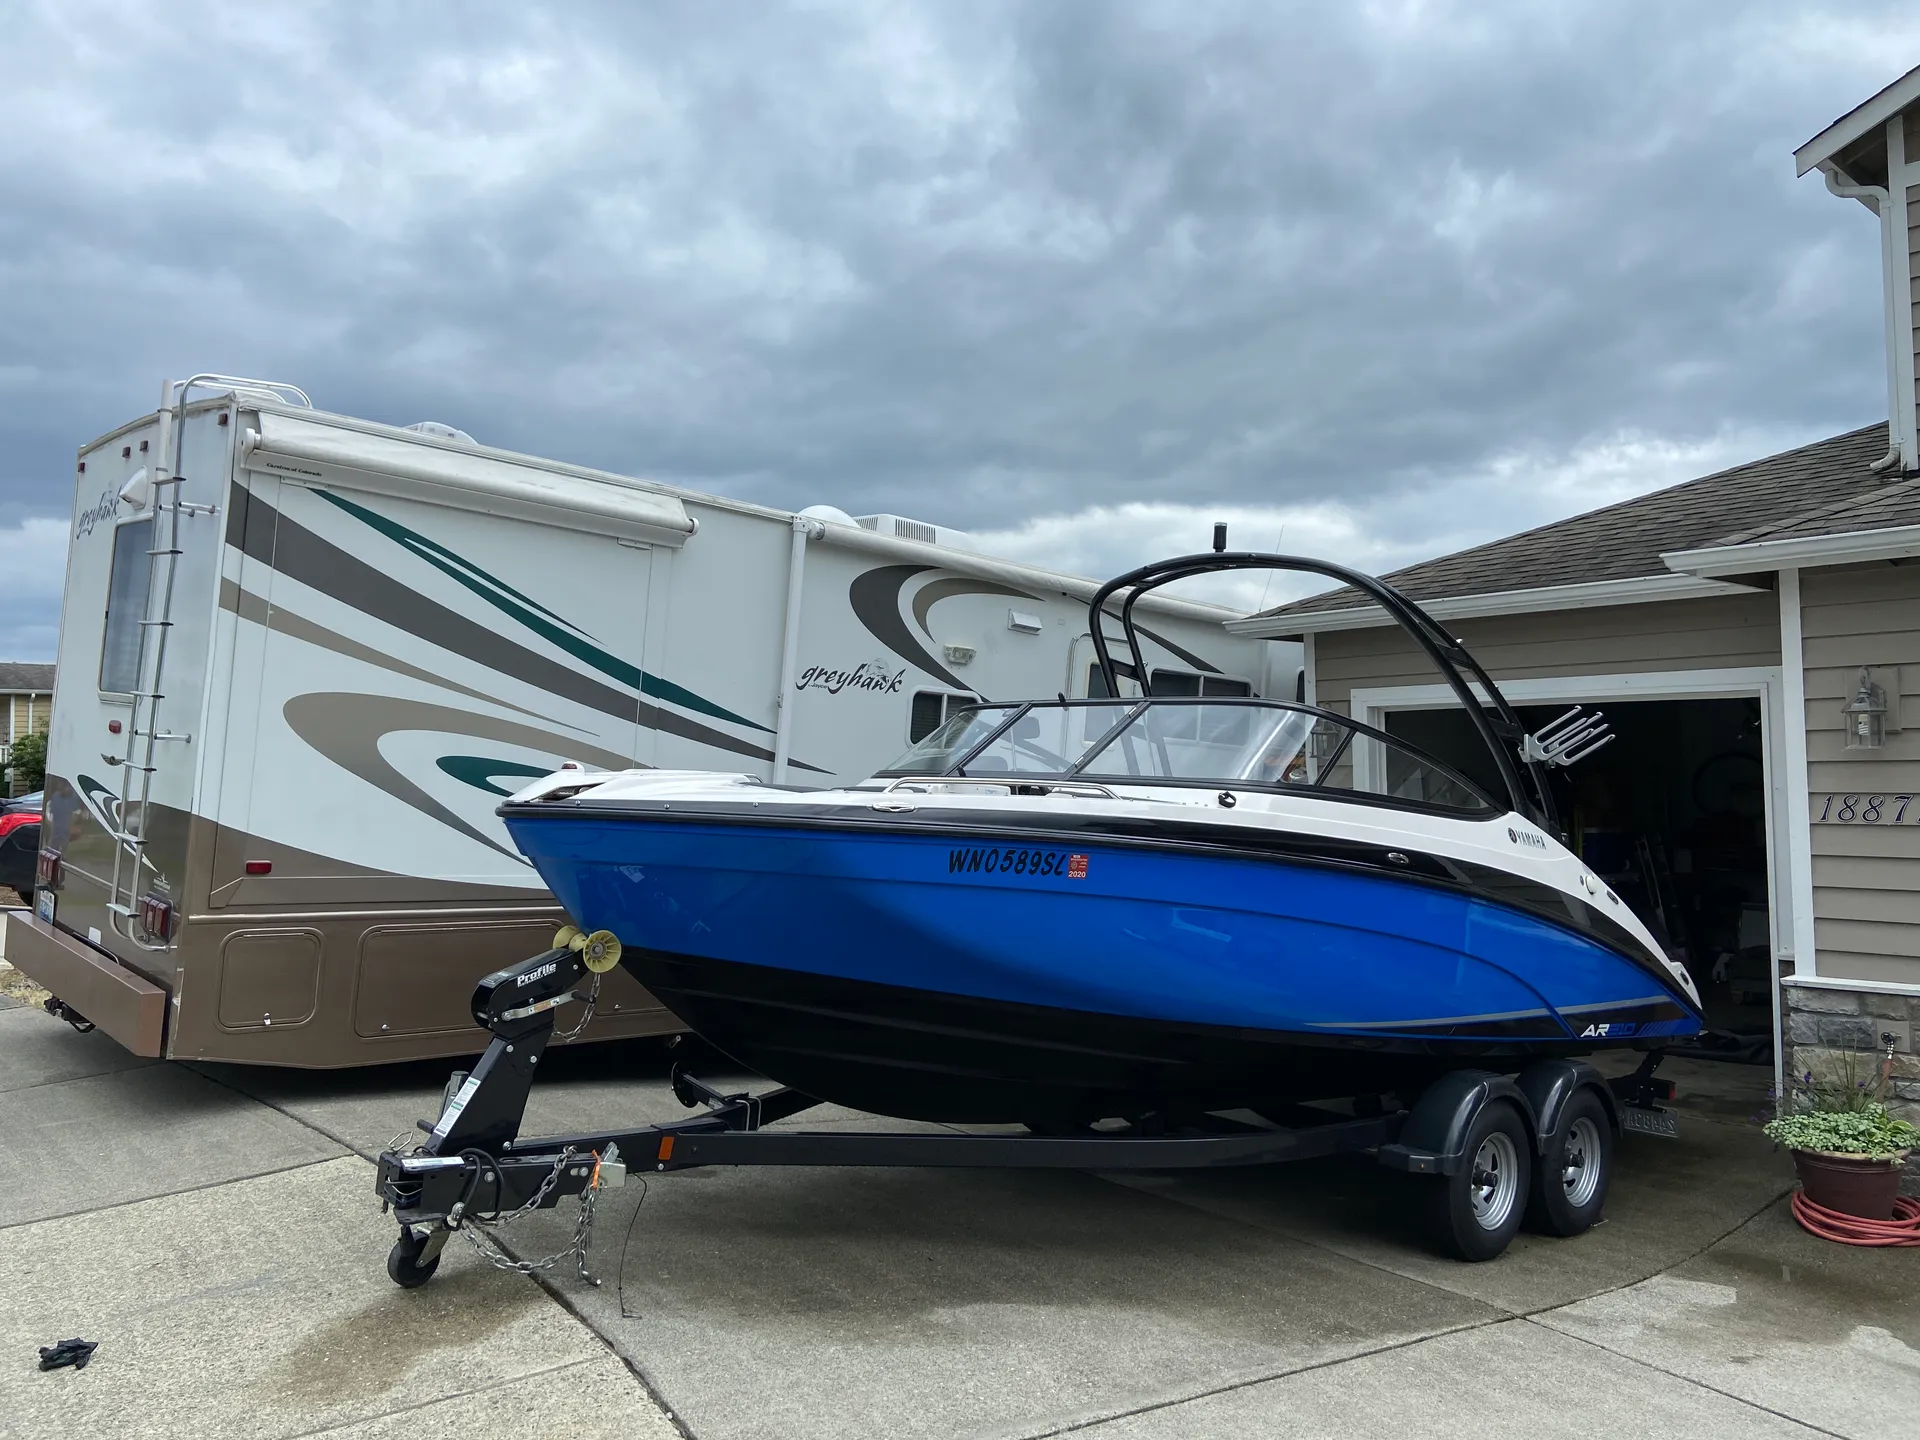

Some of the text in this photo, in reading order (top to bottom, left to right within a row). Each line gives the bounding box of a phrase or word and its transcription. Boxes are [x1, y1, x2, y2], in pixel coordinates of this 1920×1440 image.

[795, 662, 907, 695] greyhawk
[1818, 793, 1920, 824] 1887
[1515, 829, 1547, 851] YAMAHA
[1068, 870, 1087, 878] 2020
[517, 963, 557, 985] Profile
